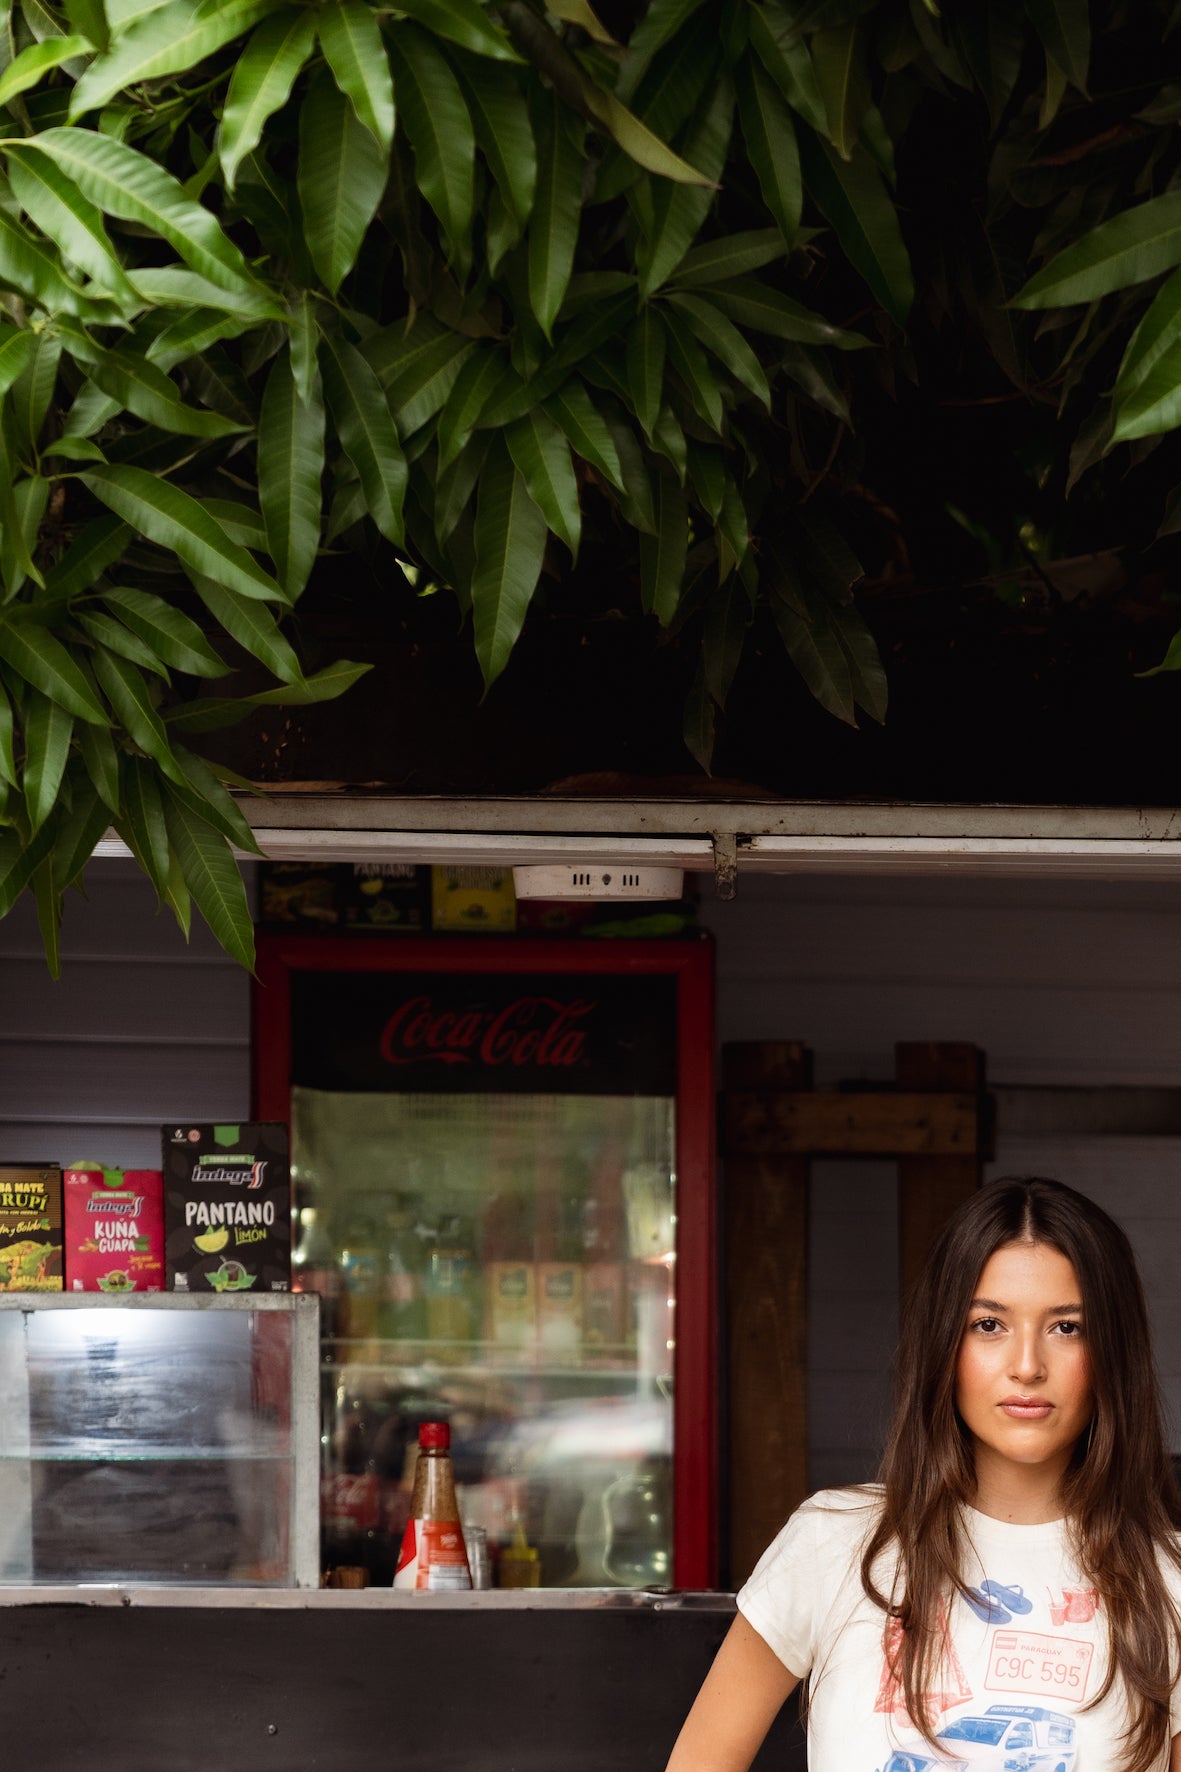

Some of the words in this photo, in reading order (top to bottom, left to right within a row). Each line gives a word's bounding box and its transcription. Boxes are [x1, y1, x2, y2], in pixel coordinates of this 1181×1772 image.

[380, 995, 597, 1067] Coca-Cola
[14, 1183, 45, 1193] MATE
[185, 1201, 275, 1226] PANTANO
[94, 1217, 140, 1240] KUÑA
[99, 1238, 136, 1254] GUAPA
[1021, 1644, 1062, 1656] PARAGUAY
[995, 1656, 1035, 1679] C9C
[1040, 1661, 1081, 1687] 595
